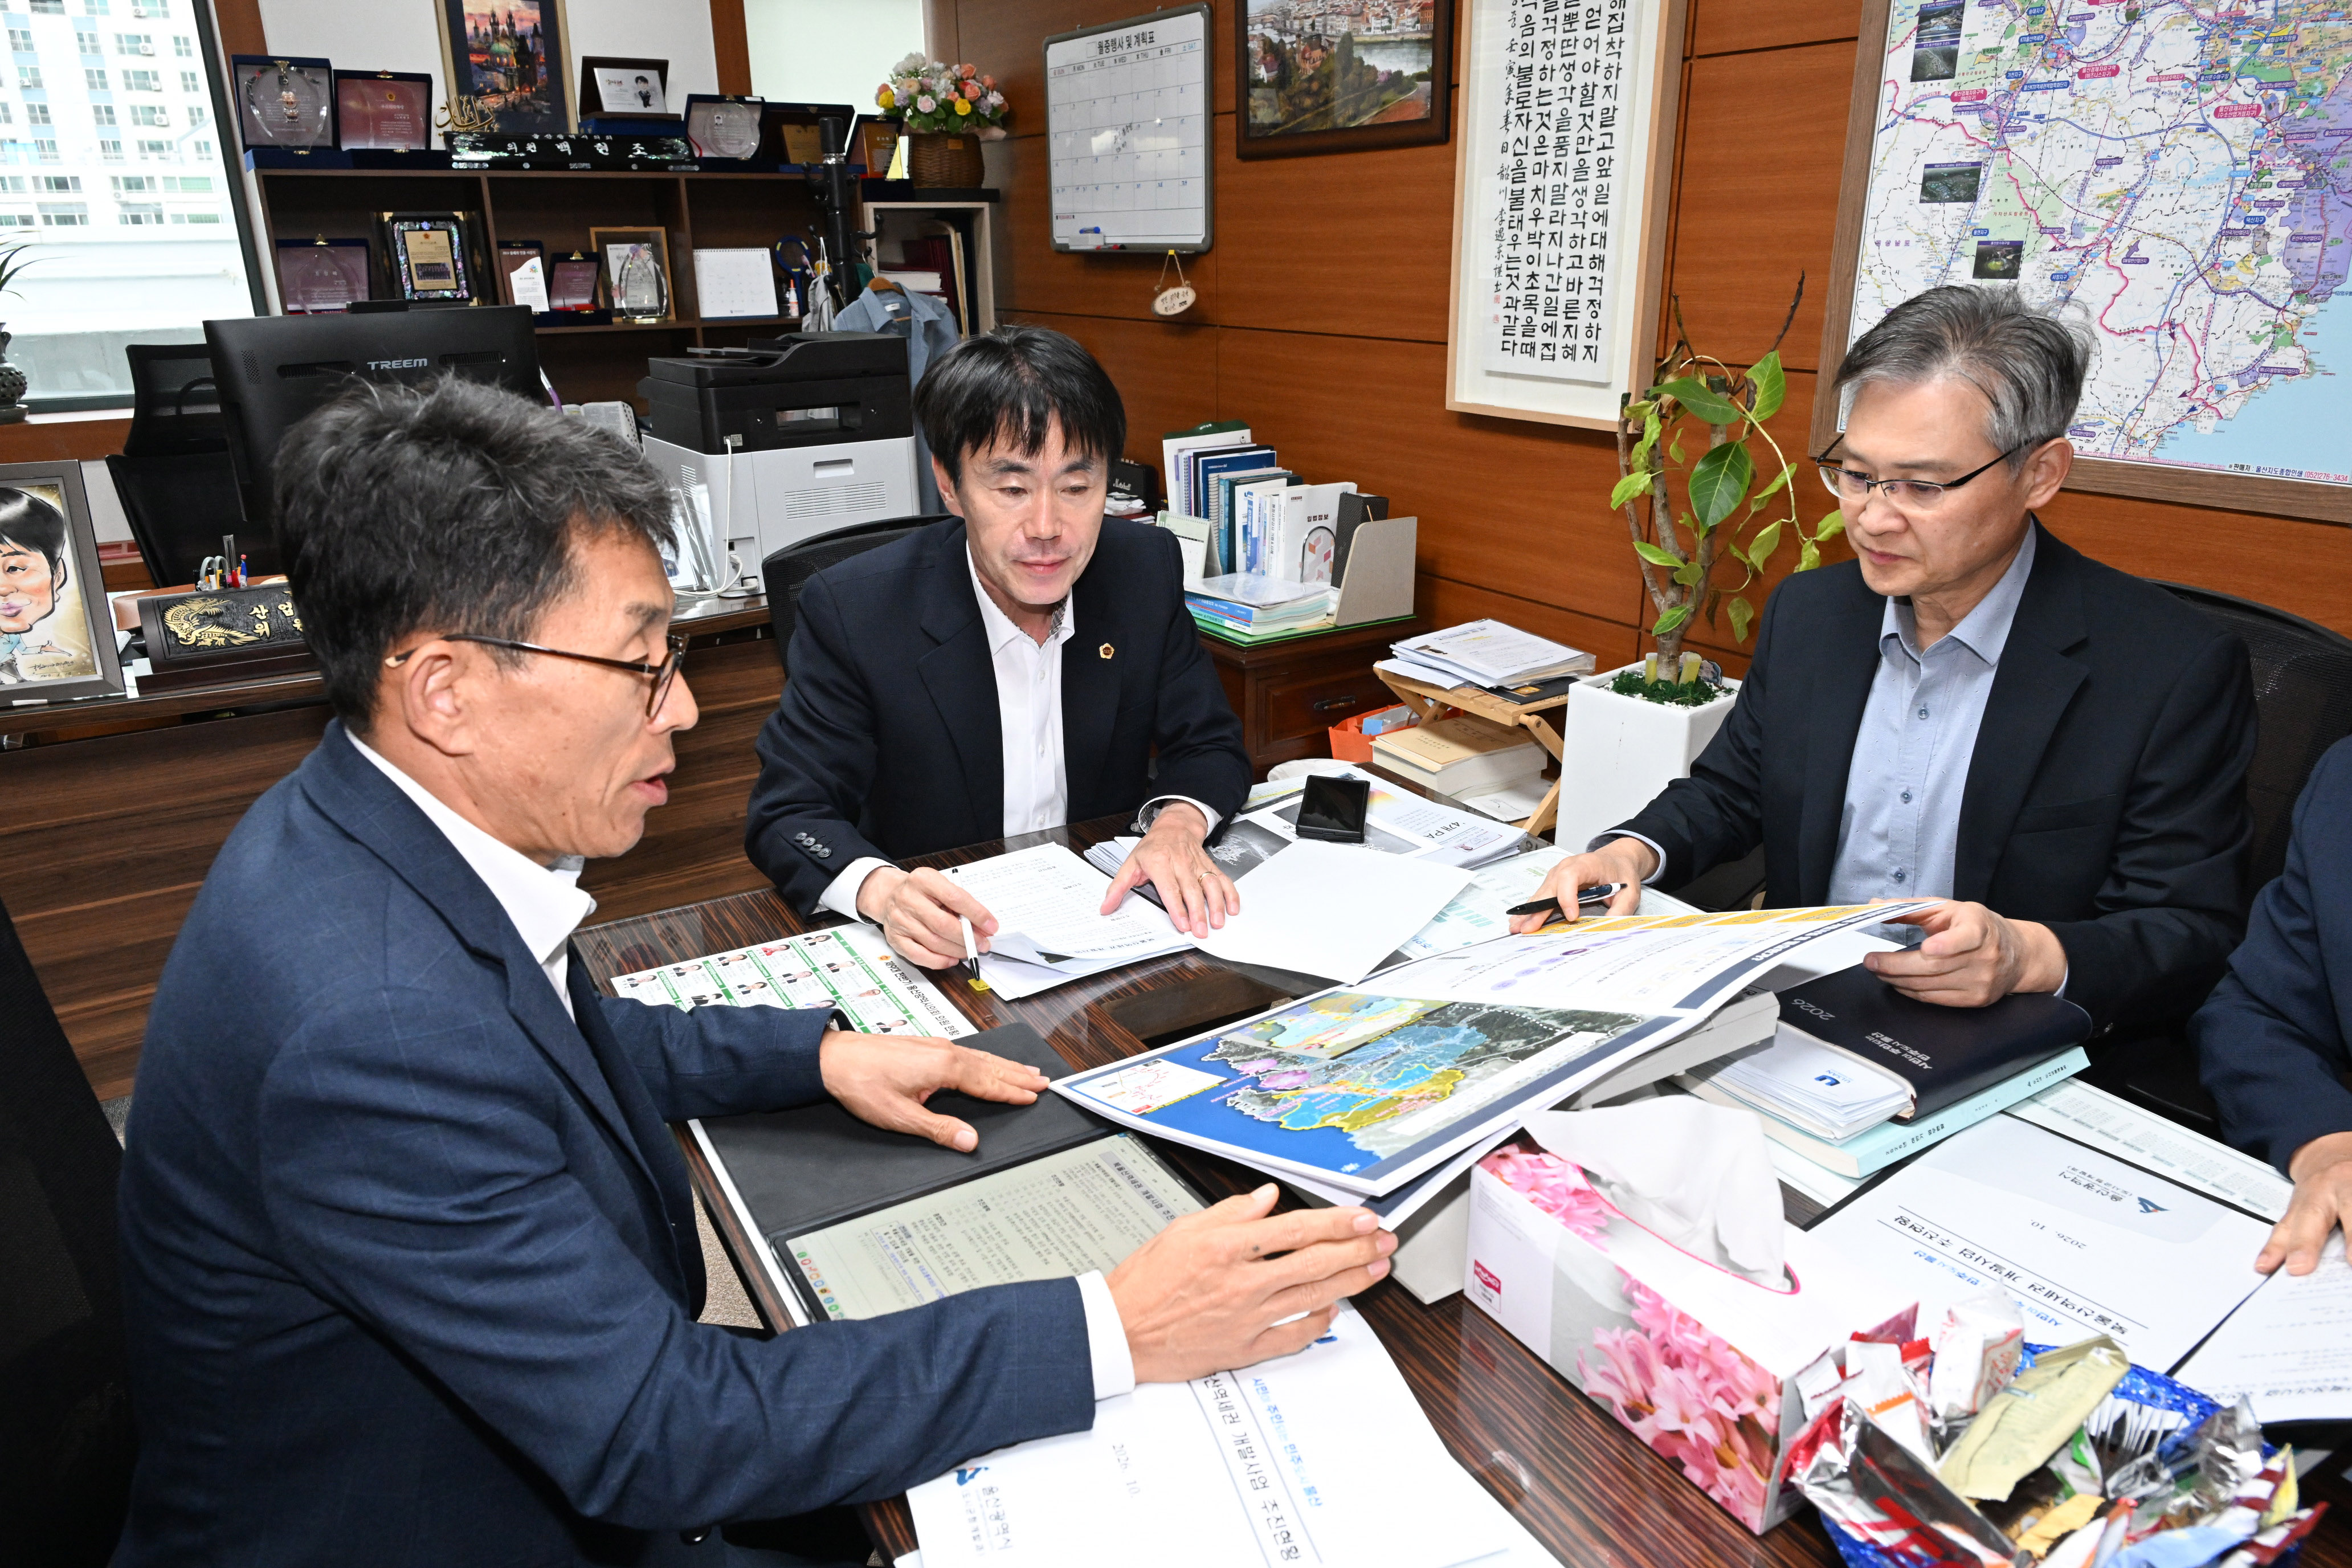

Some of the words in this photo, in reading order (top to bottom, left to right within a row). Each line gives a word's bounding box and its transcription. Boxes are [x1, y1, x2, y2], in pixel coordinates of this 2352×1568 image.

[1097, 36, 1124, 55] 월중행사
[1134, 30, 1155, 47] 계획표
[366, 357, 428, 370] TREEM
[2233, 463, 2251, 472] 판매처
[2255, 466, 2303, 477] 울산지도종합인쇄
[2304, 471, 2348, 481] (052)276-3434
[1307, 513, 1329, 522] 입법정보
[1791, 998, 1836, 1021] 2026
[2057, 1170, 2124, 1202] 울산광역시
[1893, 1214, 1954, 1248] 추진현황
[2030, 1219, 2047, 1231] 10.
[2055, 1231, 2088, 1250] 2026.
[1958, 1247, 2023, 1284] 개발사업
[2027, 1281, 2129, 1335] 북울산역세권
[1112, 1443, 1128, 1475] 2026.
[1230, 1431, 1271, 1492] 개발사업
[1260, 1498, 1302, 1562] 추진현황
[982, 1486, 1014, 1551] 울산광역시
